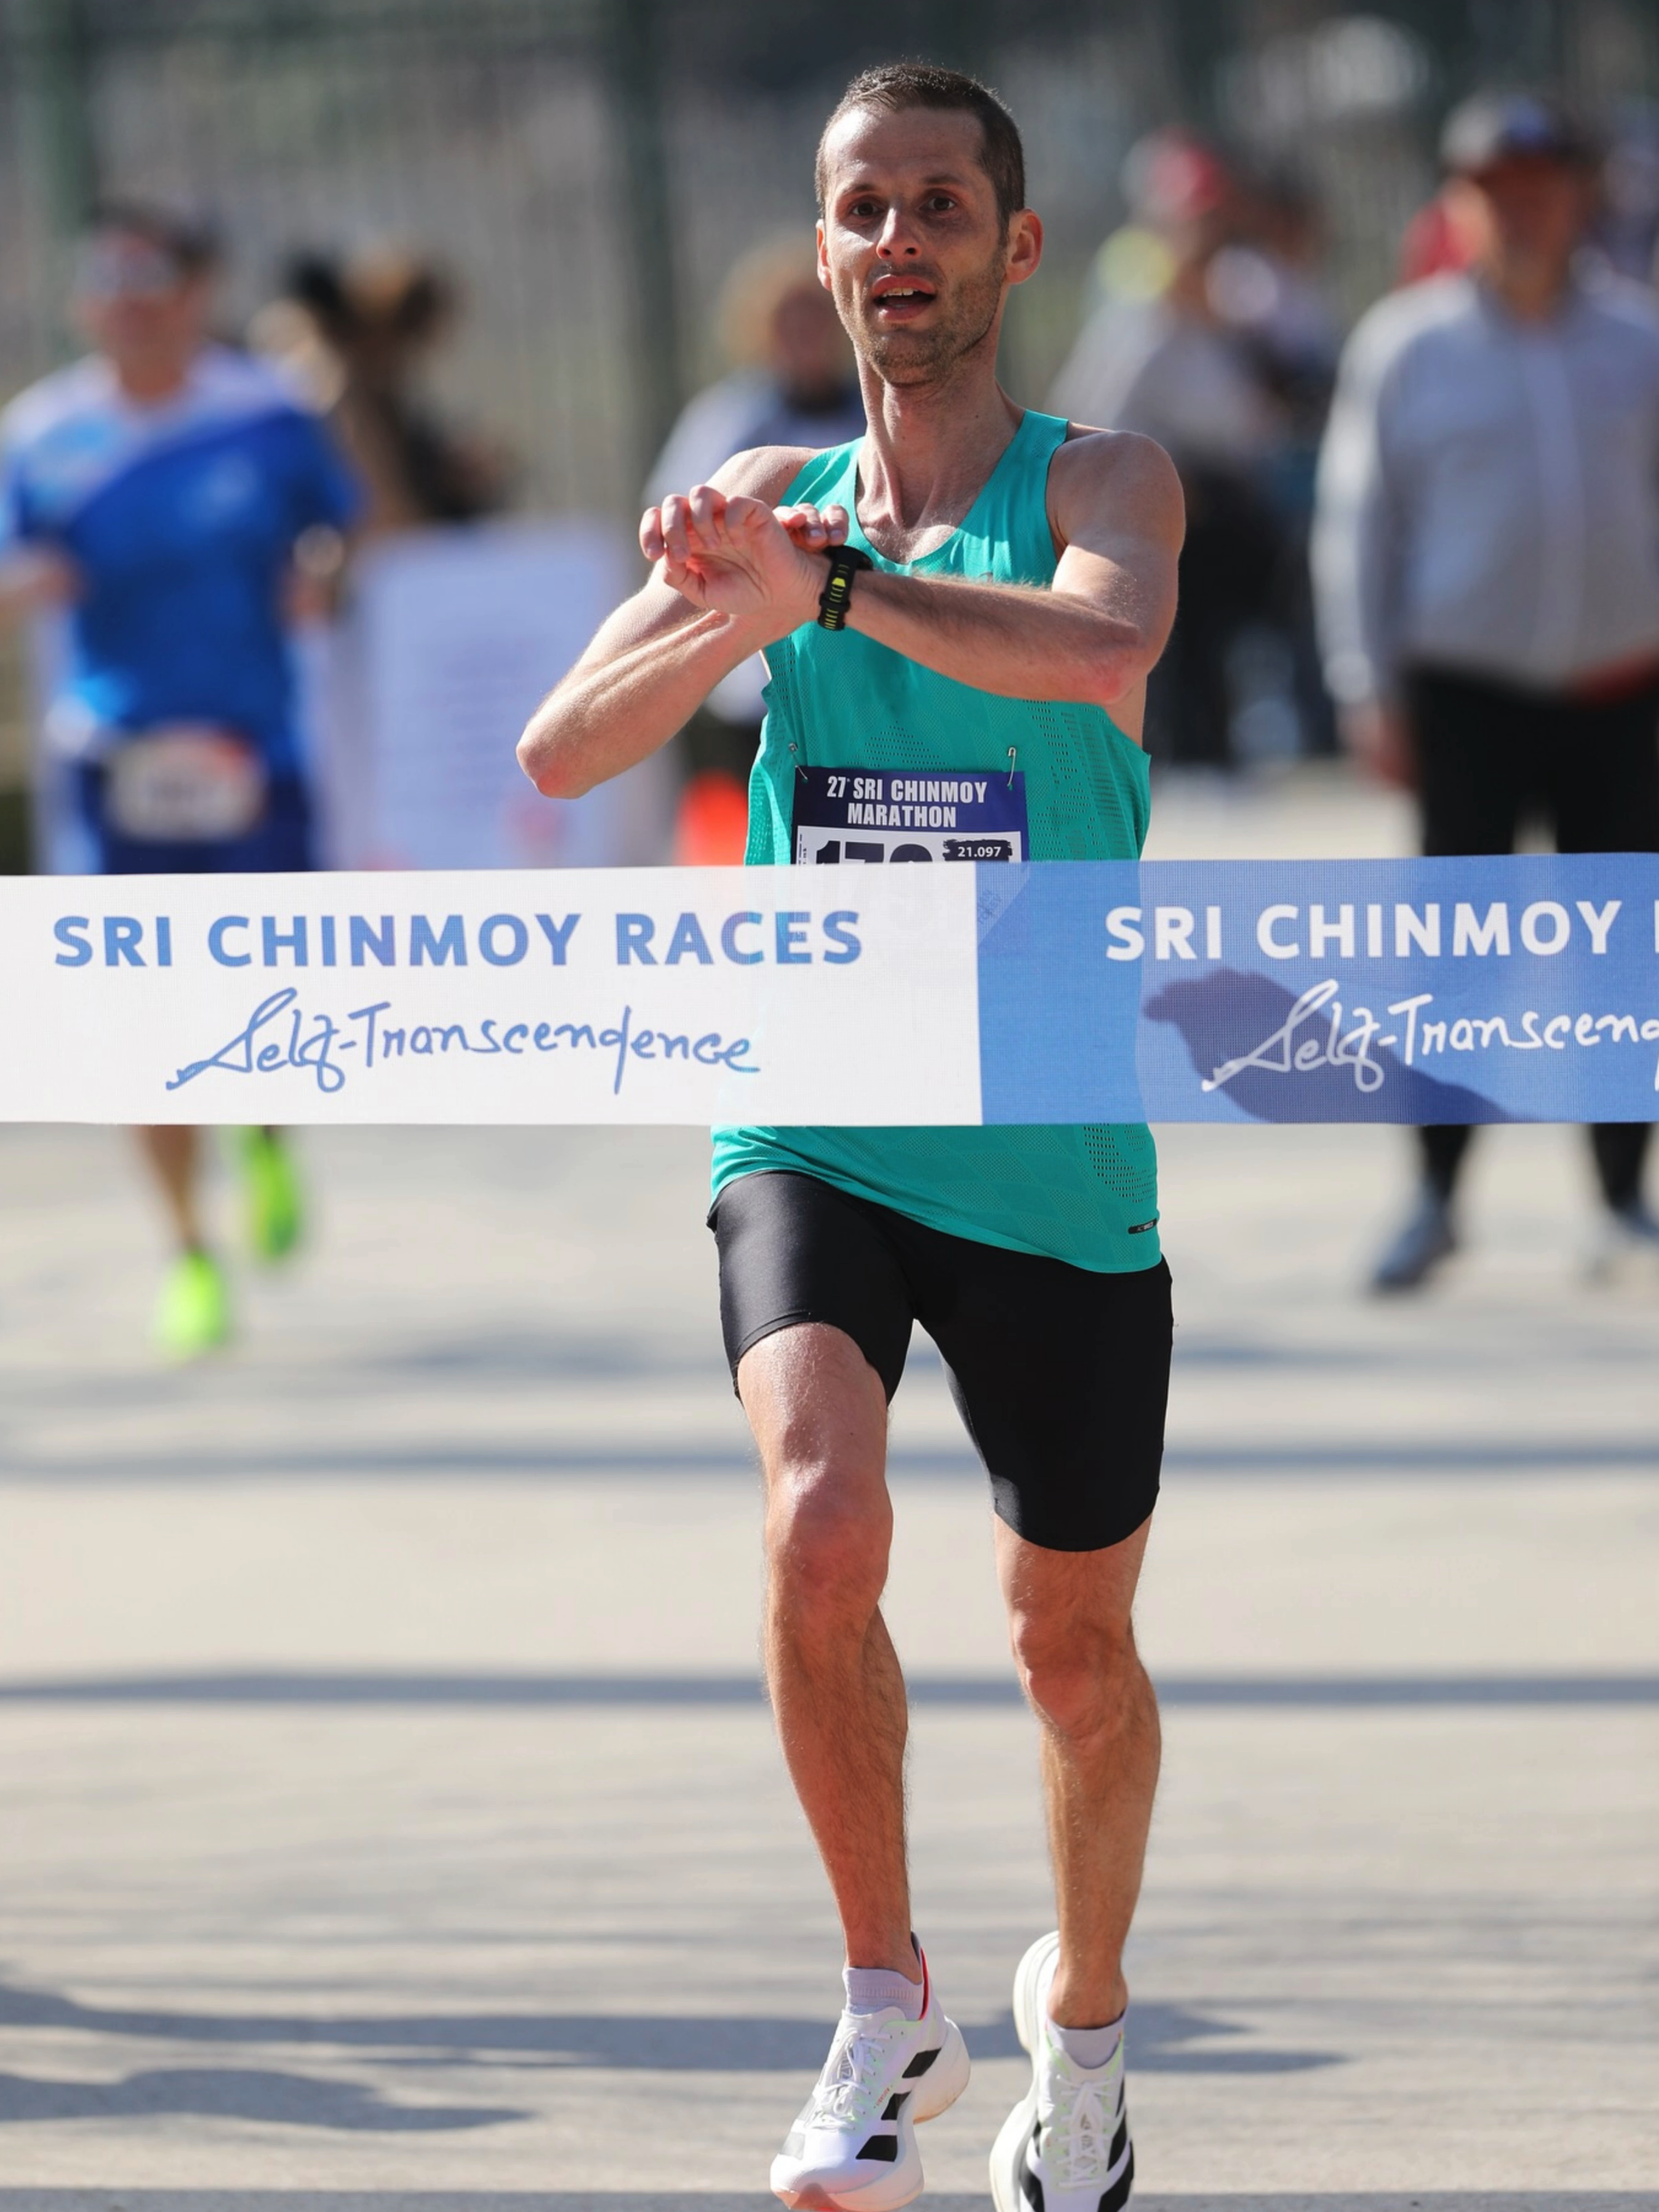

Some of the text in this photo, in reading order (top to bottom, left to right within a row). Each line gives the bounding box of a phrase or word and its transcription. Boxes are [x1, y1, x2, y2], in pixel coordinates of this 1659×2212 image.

[853, 777, 883, 800] SRI
[891, 779, 988, 804] CHINMOY
[847, 803, 957, 828] MARATHON
[957, 845, 1002, 859] 21.097
[53, 911, 862, 967] SRI CHINMOY RACES
[1105, 905, 1223, 960] SRI
[1256, 900, 1623, 958] CHINMOY
